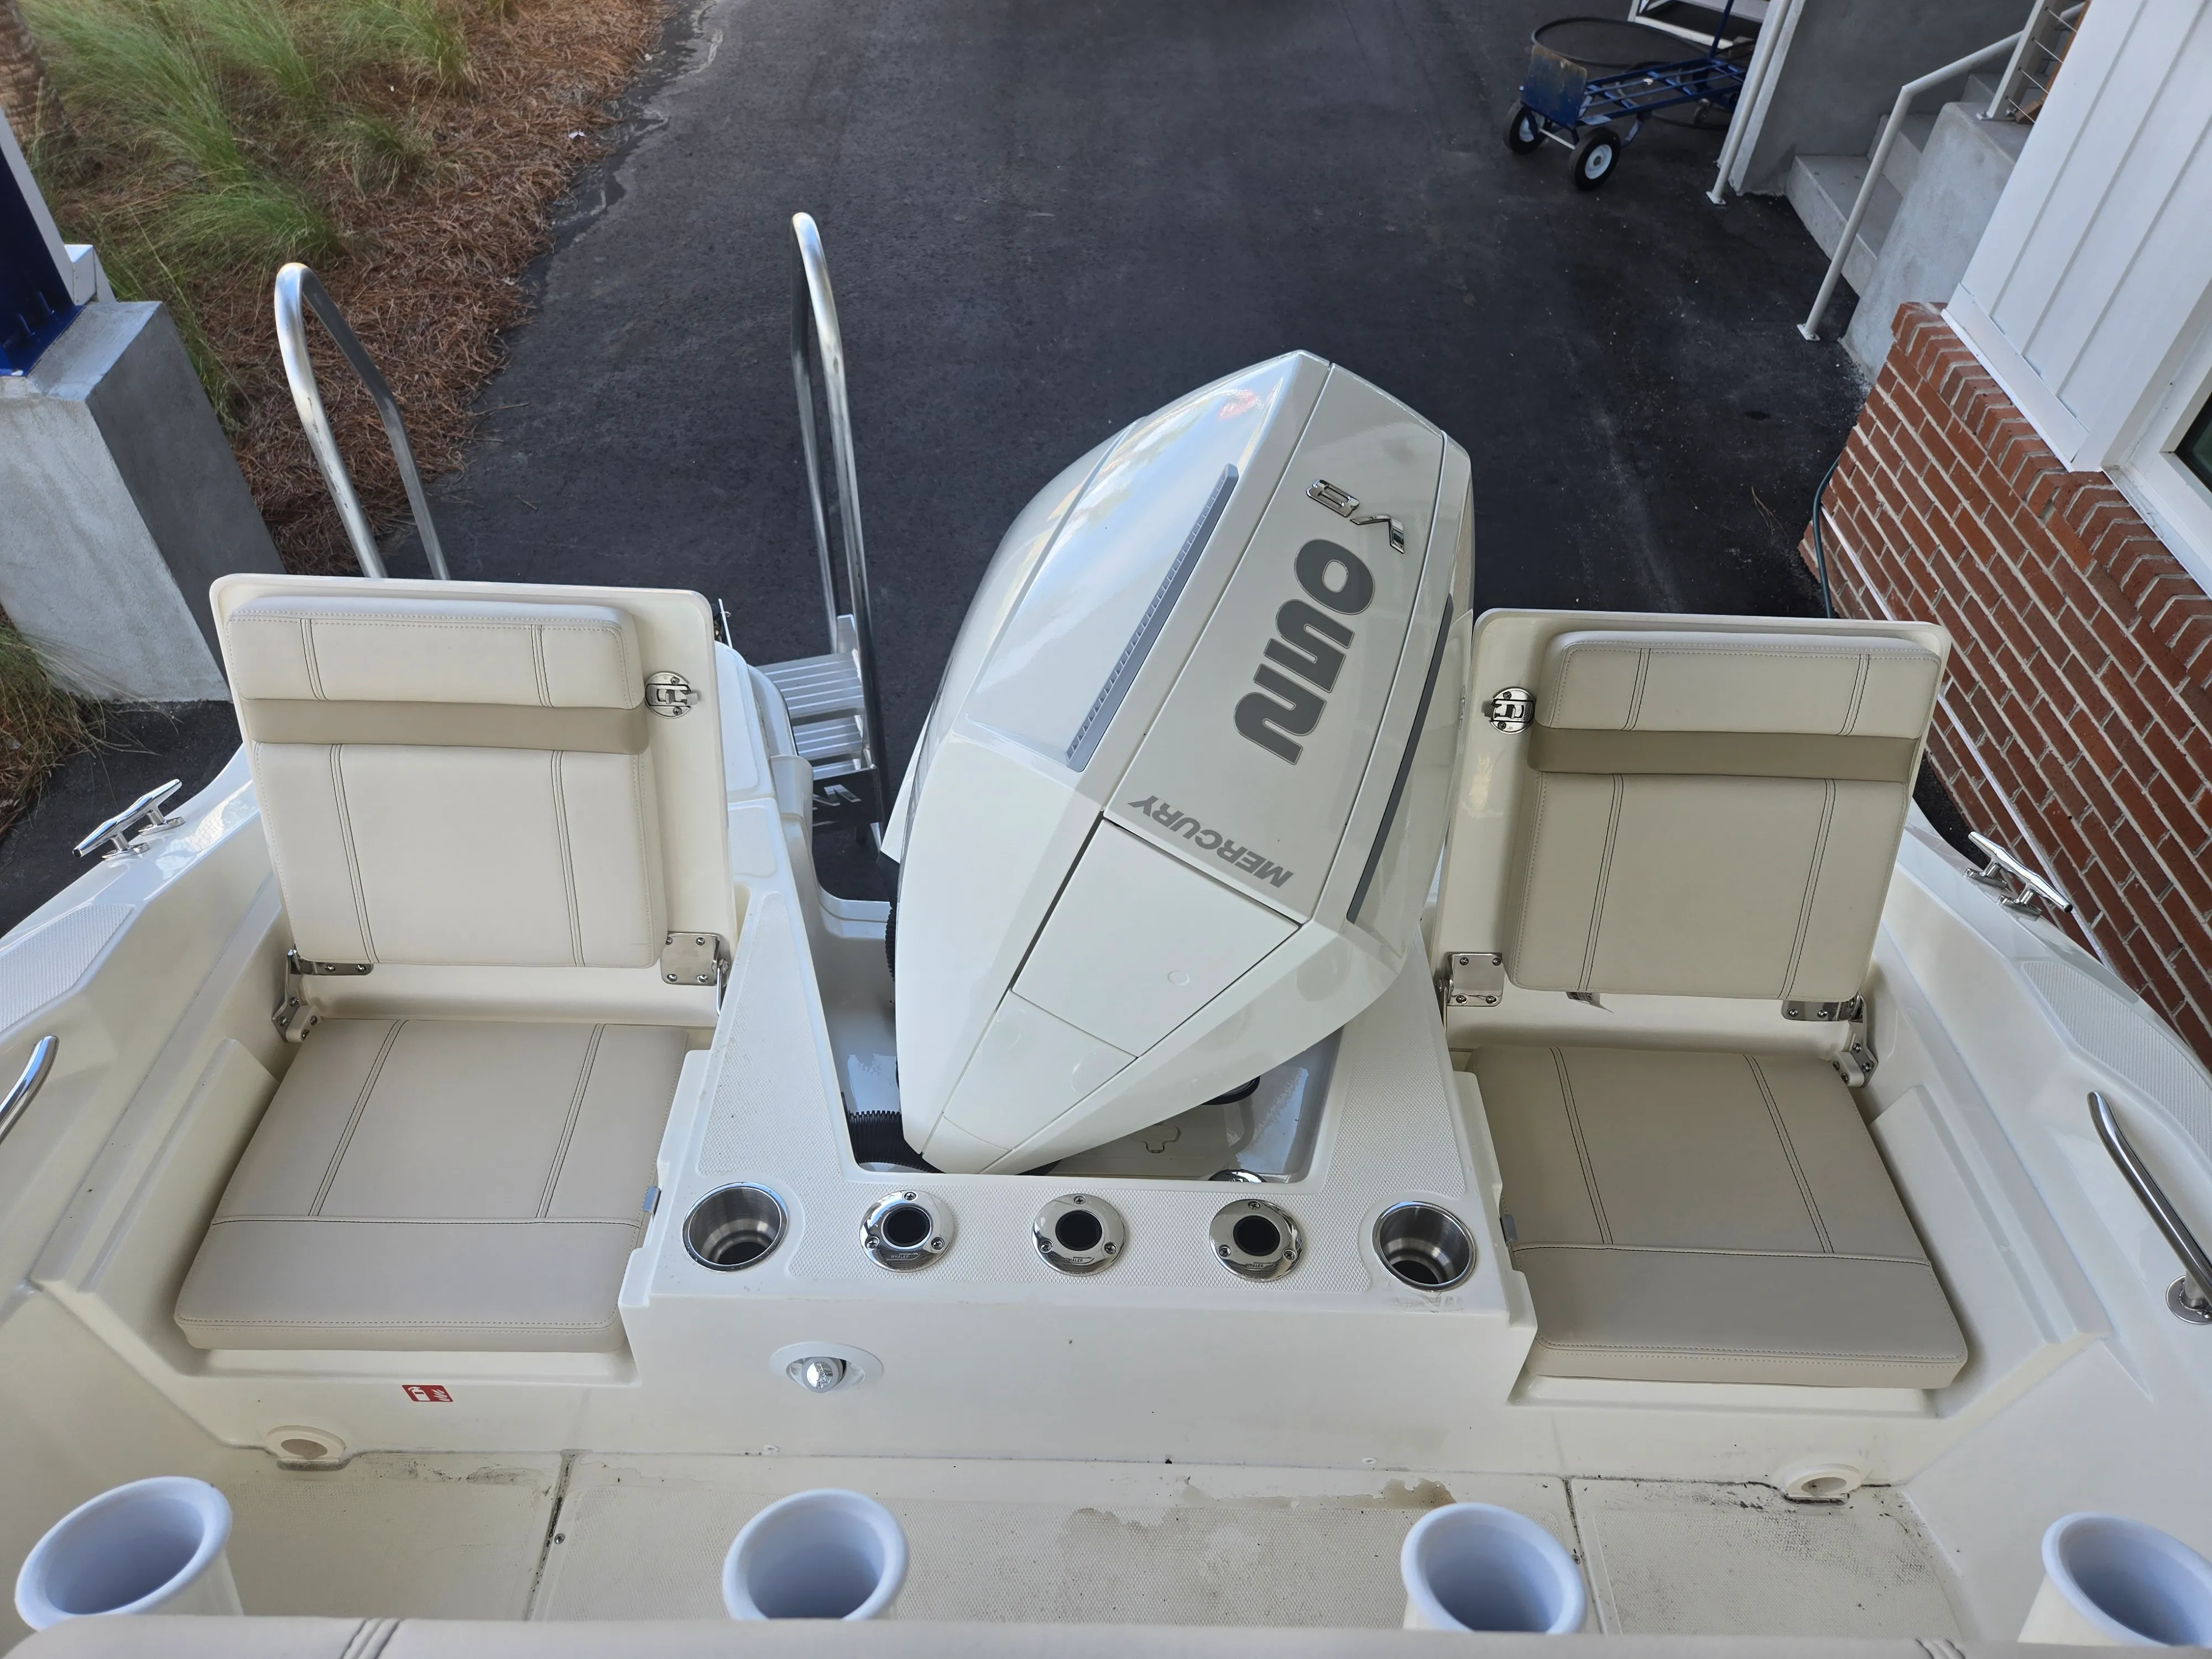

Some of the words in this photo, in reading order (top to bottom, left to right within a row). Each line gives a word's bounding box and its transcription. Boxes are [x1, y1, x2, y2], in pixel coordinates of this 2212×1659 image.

[1306, 479, 1405, 554] V8
[1233, 539, 1375, 765] 250
[1128, 795, 1294, 888] MERCURY
